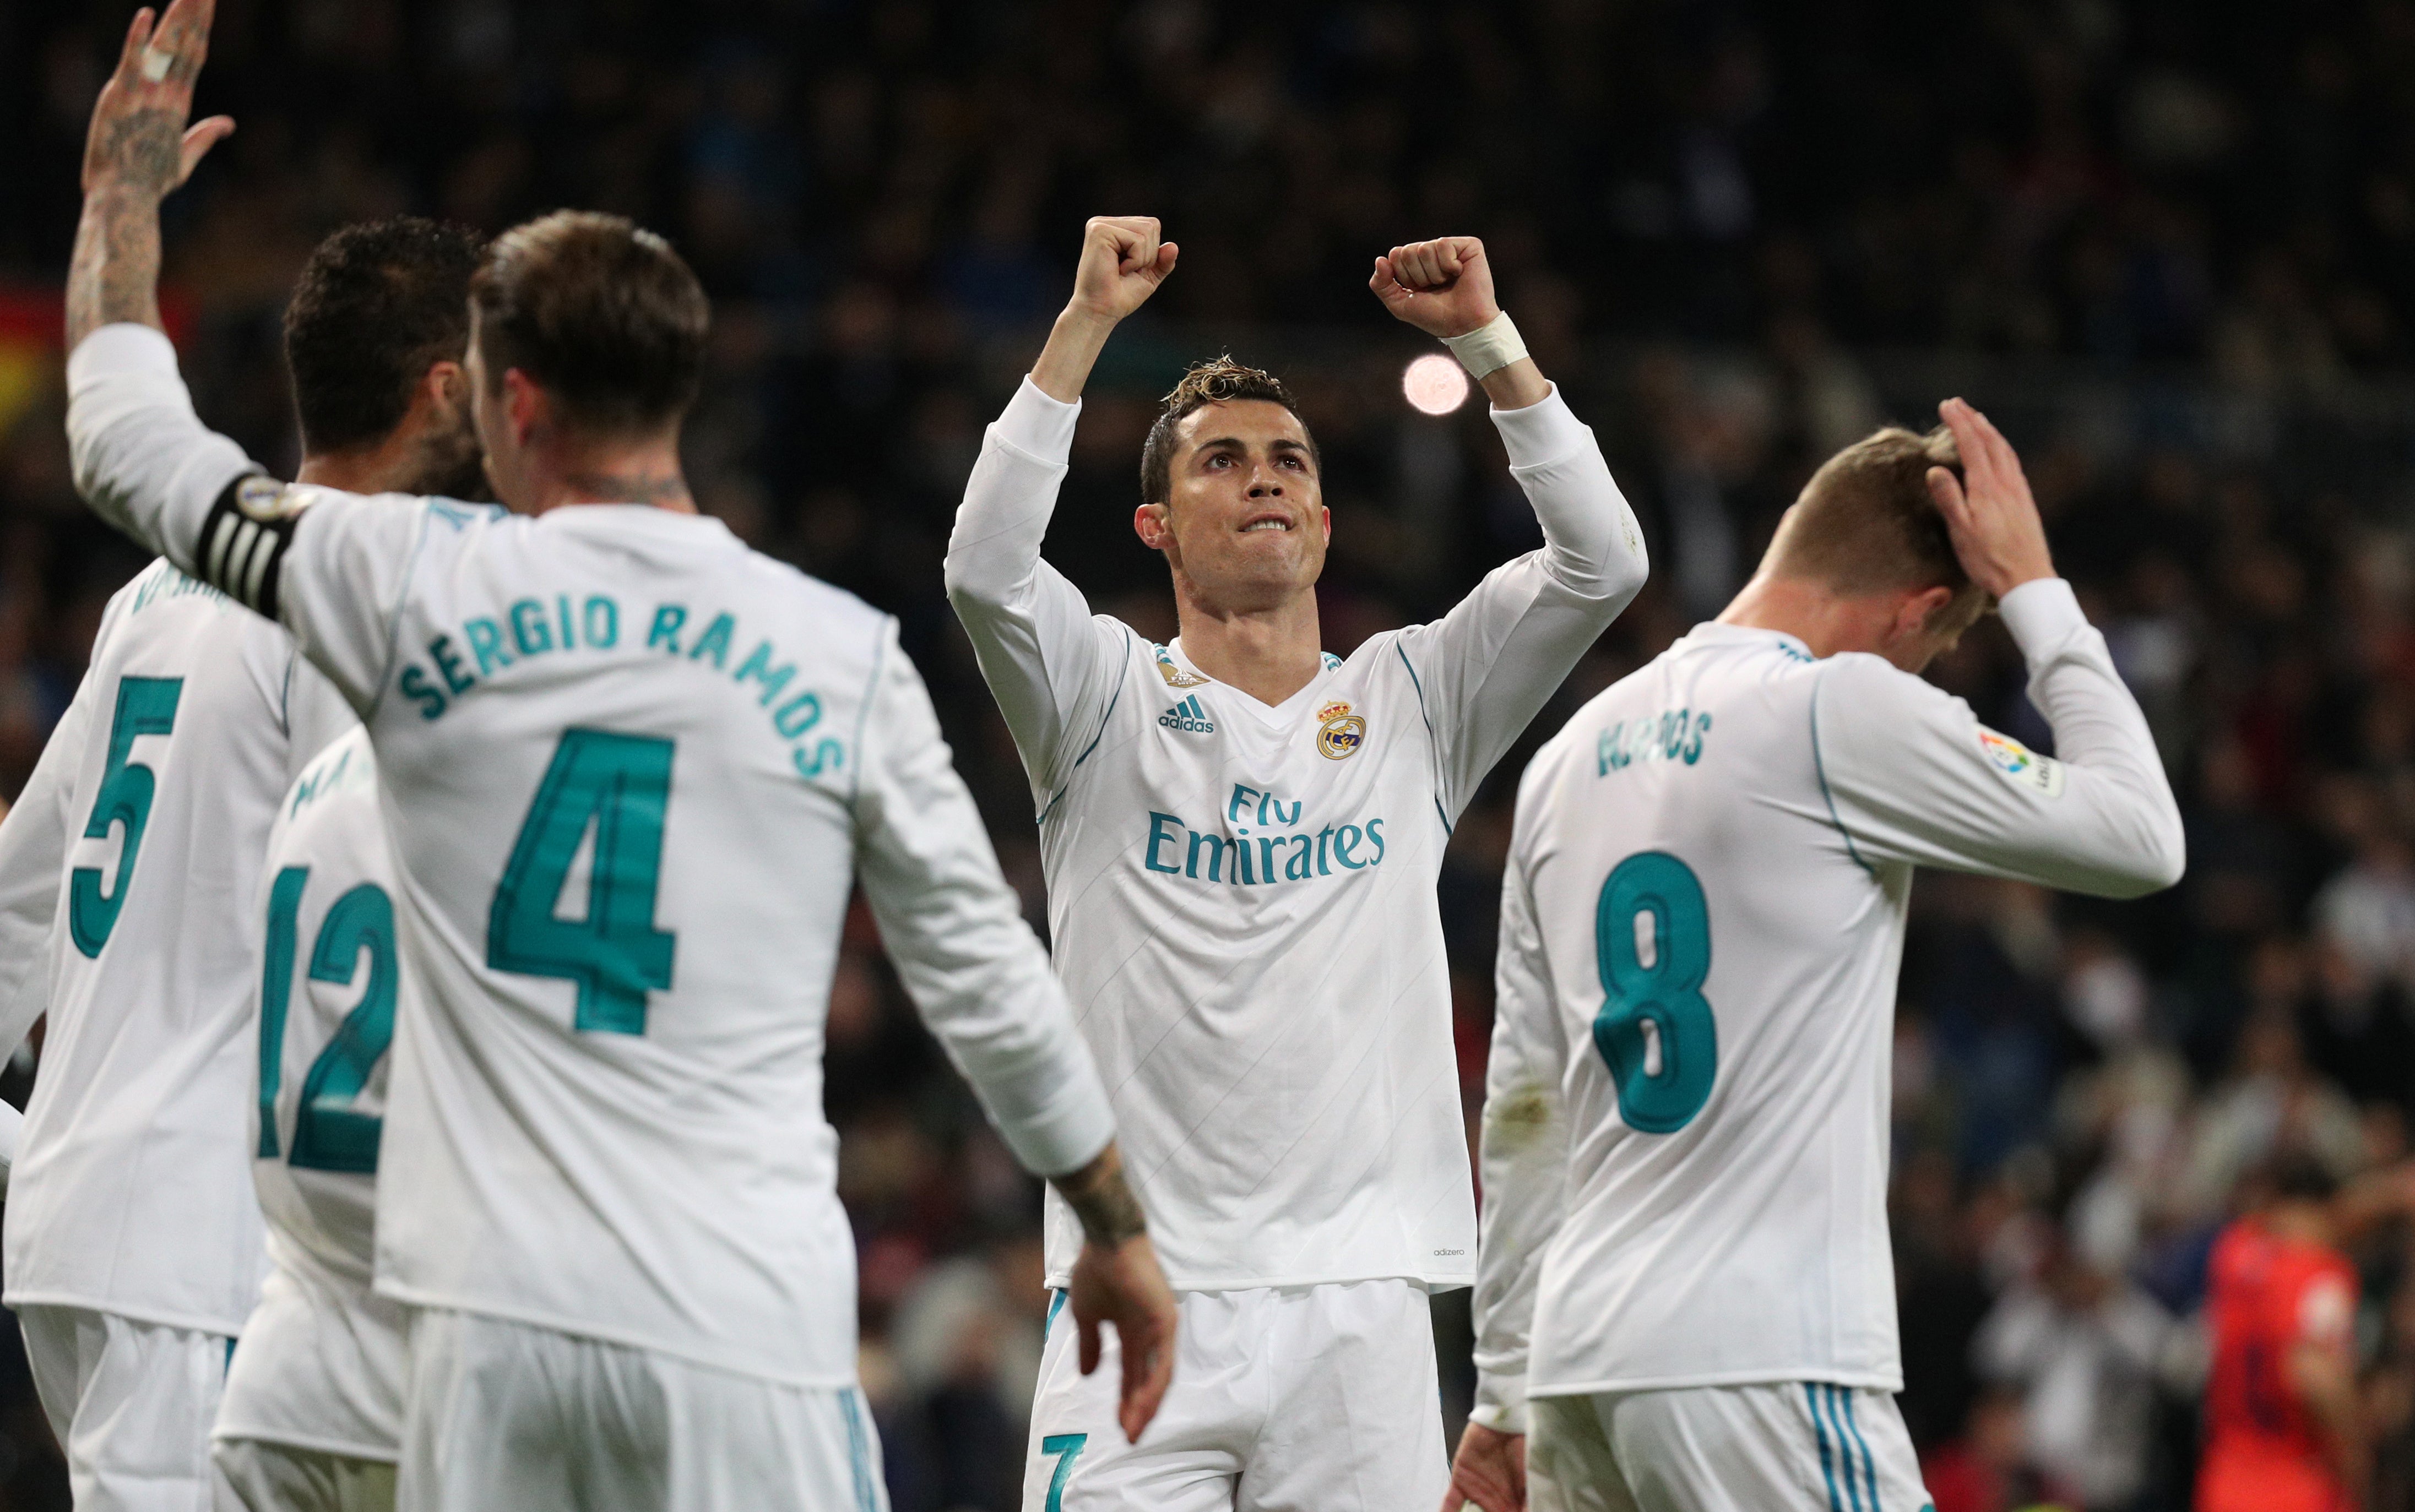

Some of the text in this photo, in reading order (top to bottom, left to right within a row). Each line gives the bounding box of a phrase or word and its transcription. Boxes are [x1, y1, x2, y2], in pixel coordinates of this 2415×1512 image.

[399, 595, 846, 780] SERGIO RAMOS
[1158, 716, 1214, 733] adidas
[70, 676, 185, 959] 5
[487, 727, 676, 1037] 4
[1145, 811, 1385, 885] Emirates
[1228, 783, 1301, 826] Fly
[258, 866, 399, 1174] 12
[1593, 851, 1718, 1134] 8
[1041, 1433, 1088, 1512] 7
